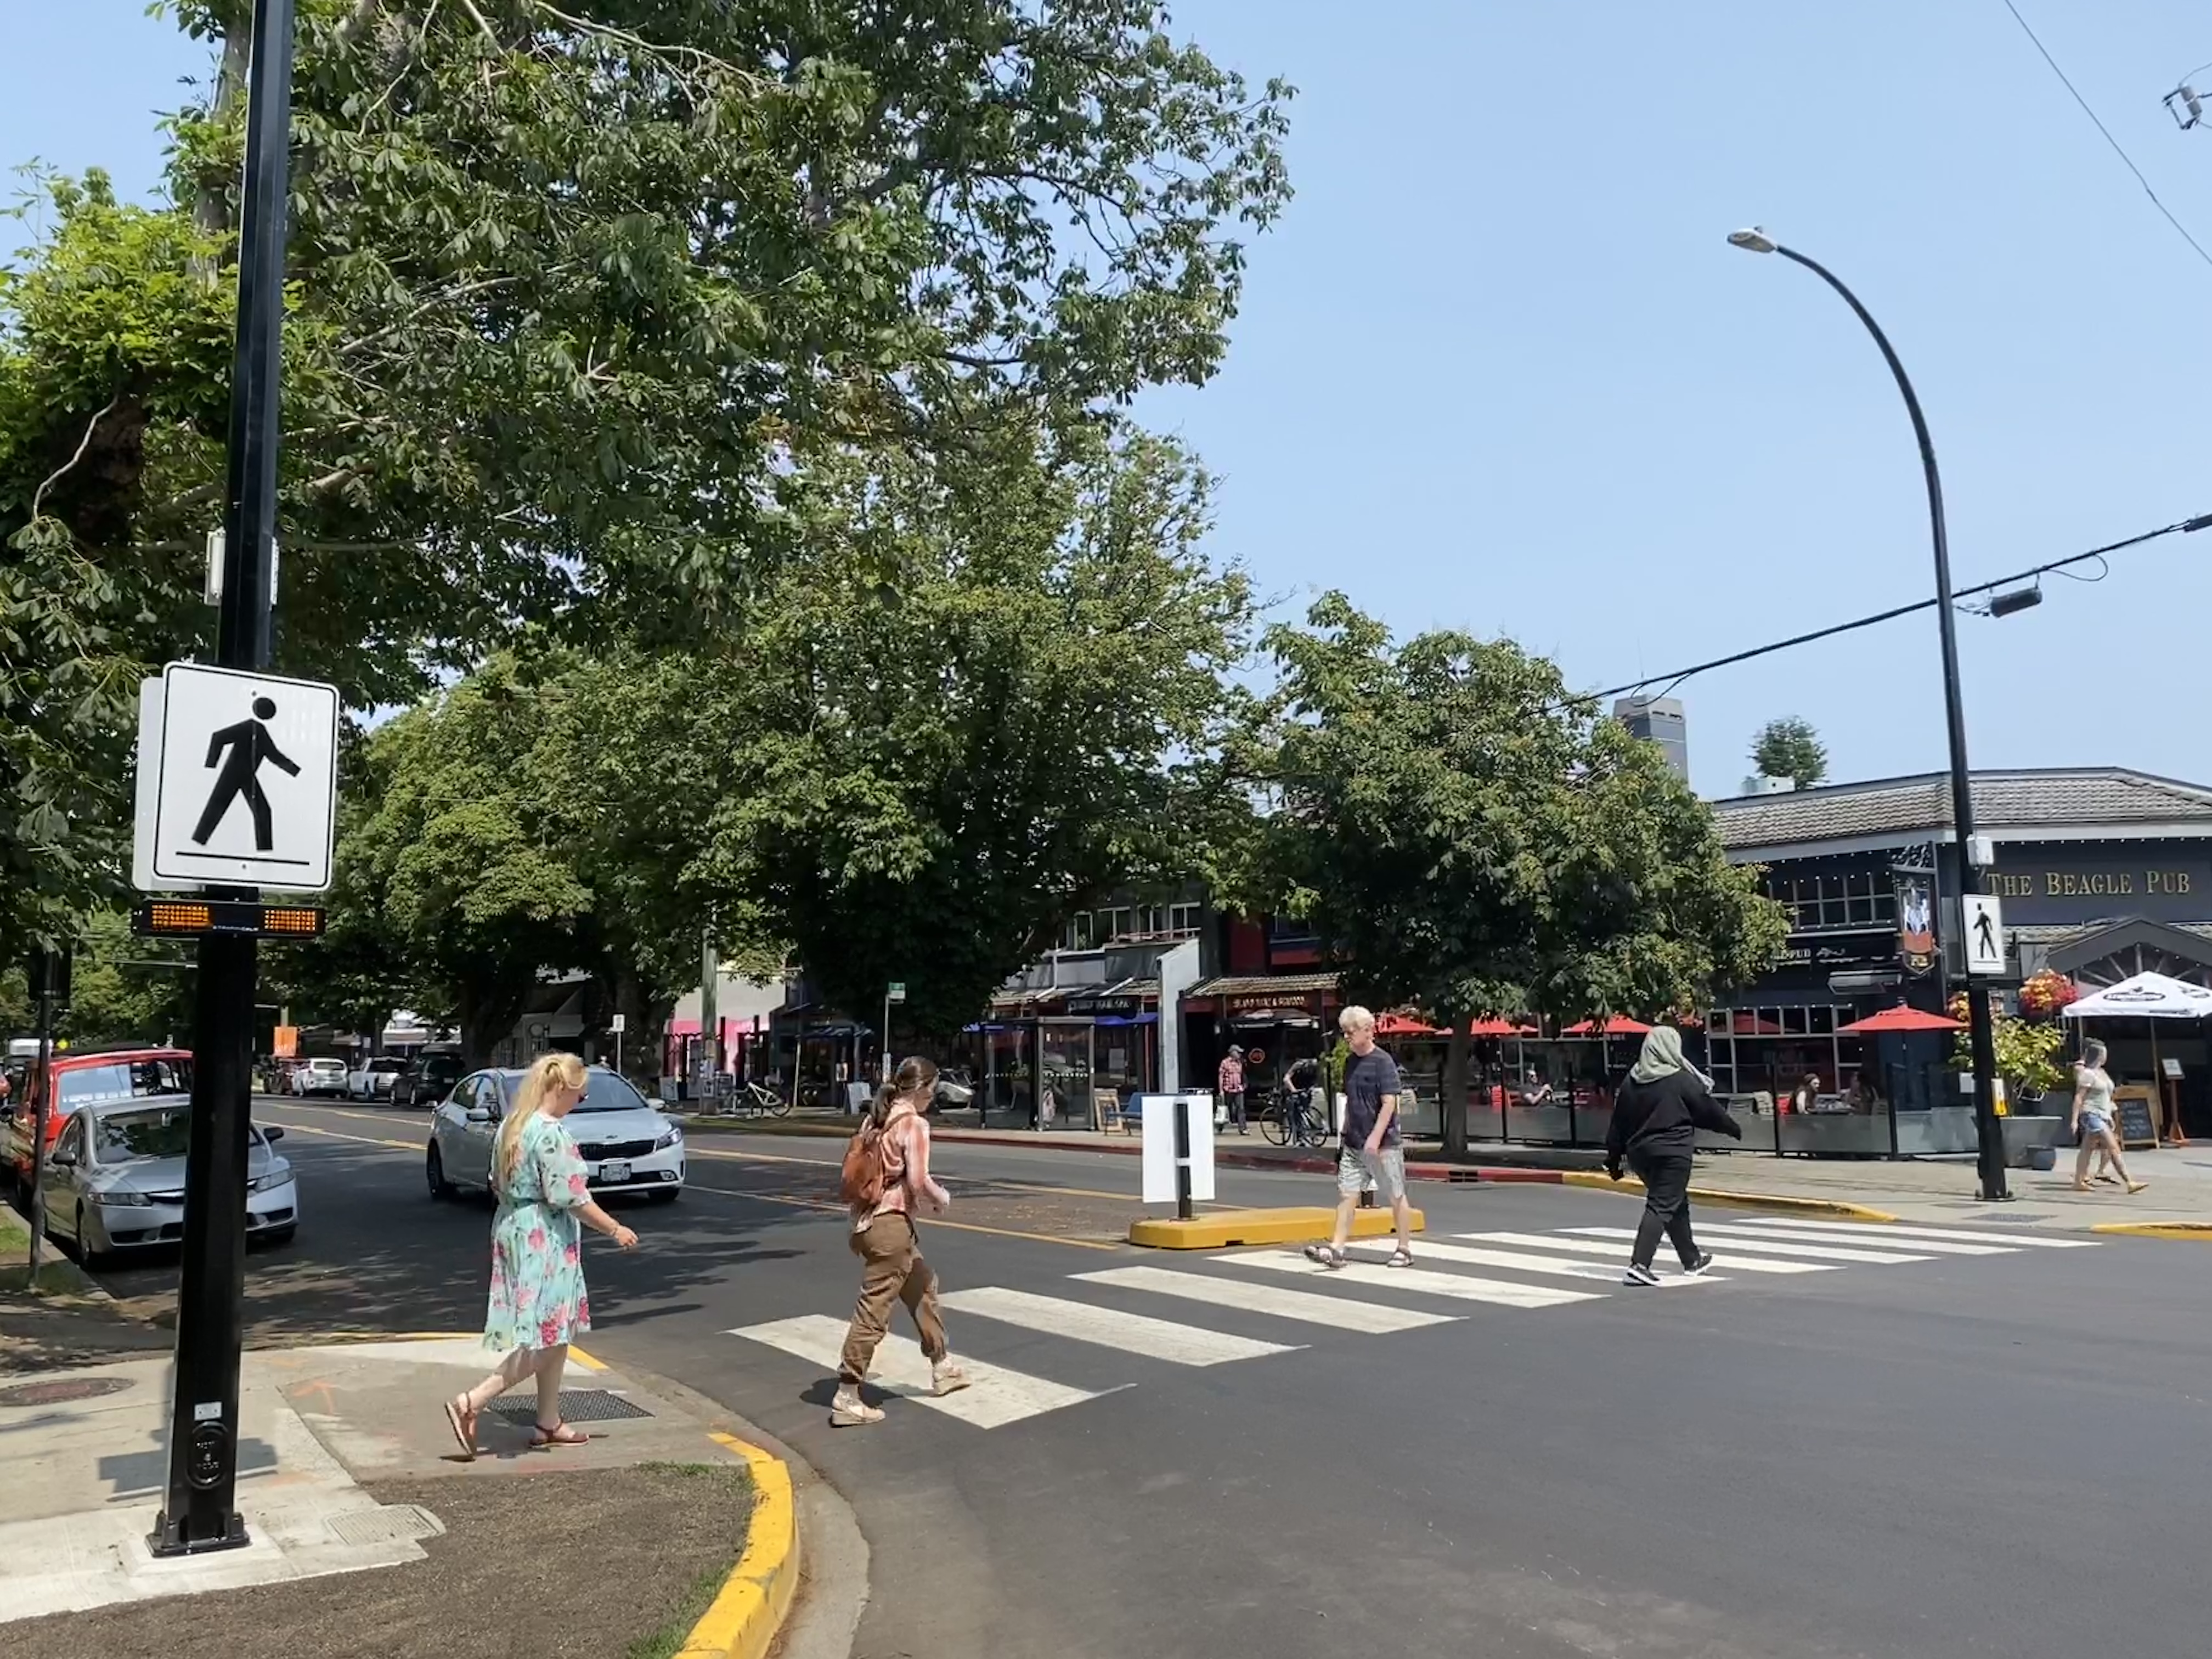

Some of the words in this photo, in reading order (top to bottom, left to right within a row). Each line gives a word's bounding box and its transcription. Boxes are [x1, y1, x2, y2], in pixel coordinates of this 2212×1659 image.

[1987, 873, 2032, 896] THE
[2046, 872, 2132, 895] BEAGLE
[2146, 871, 2190, 894] PUB
